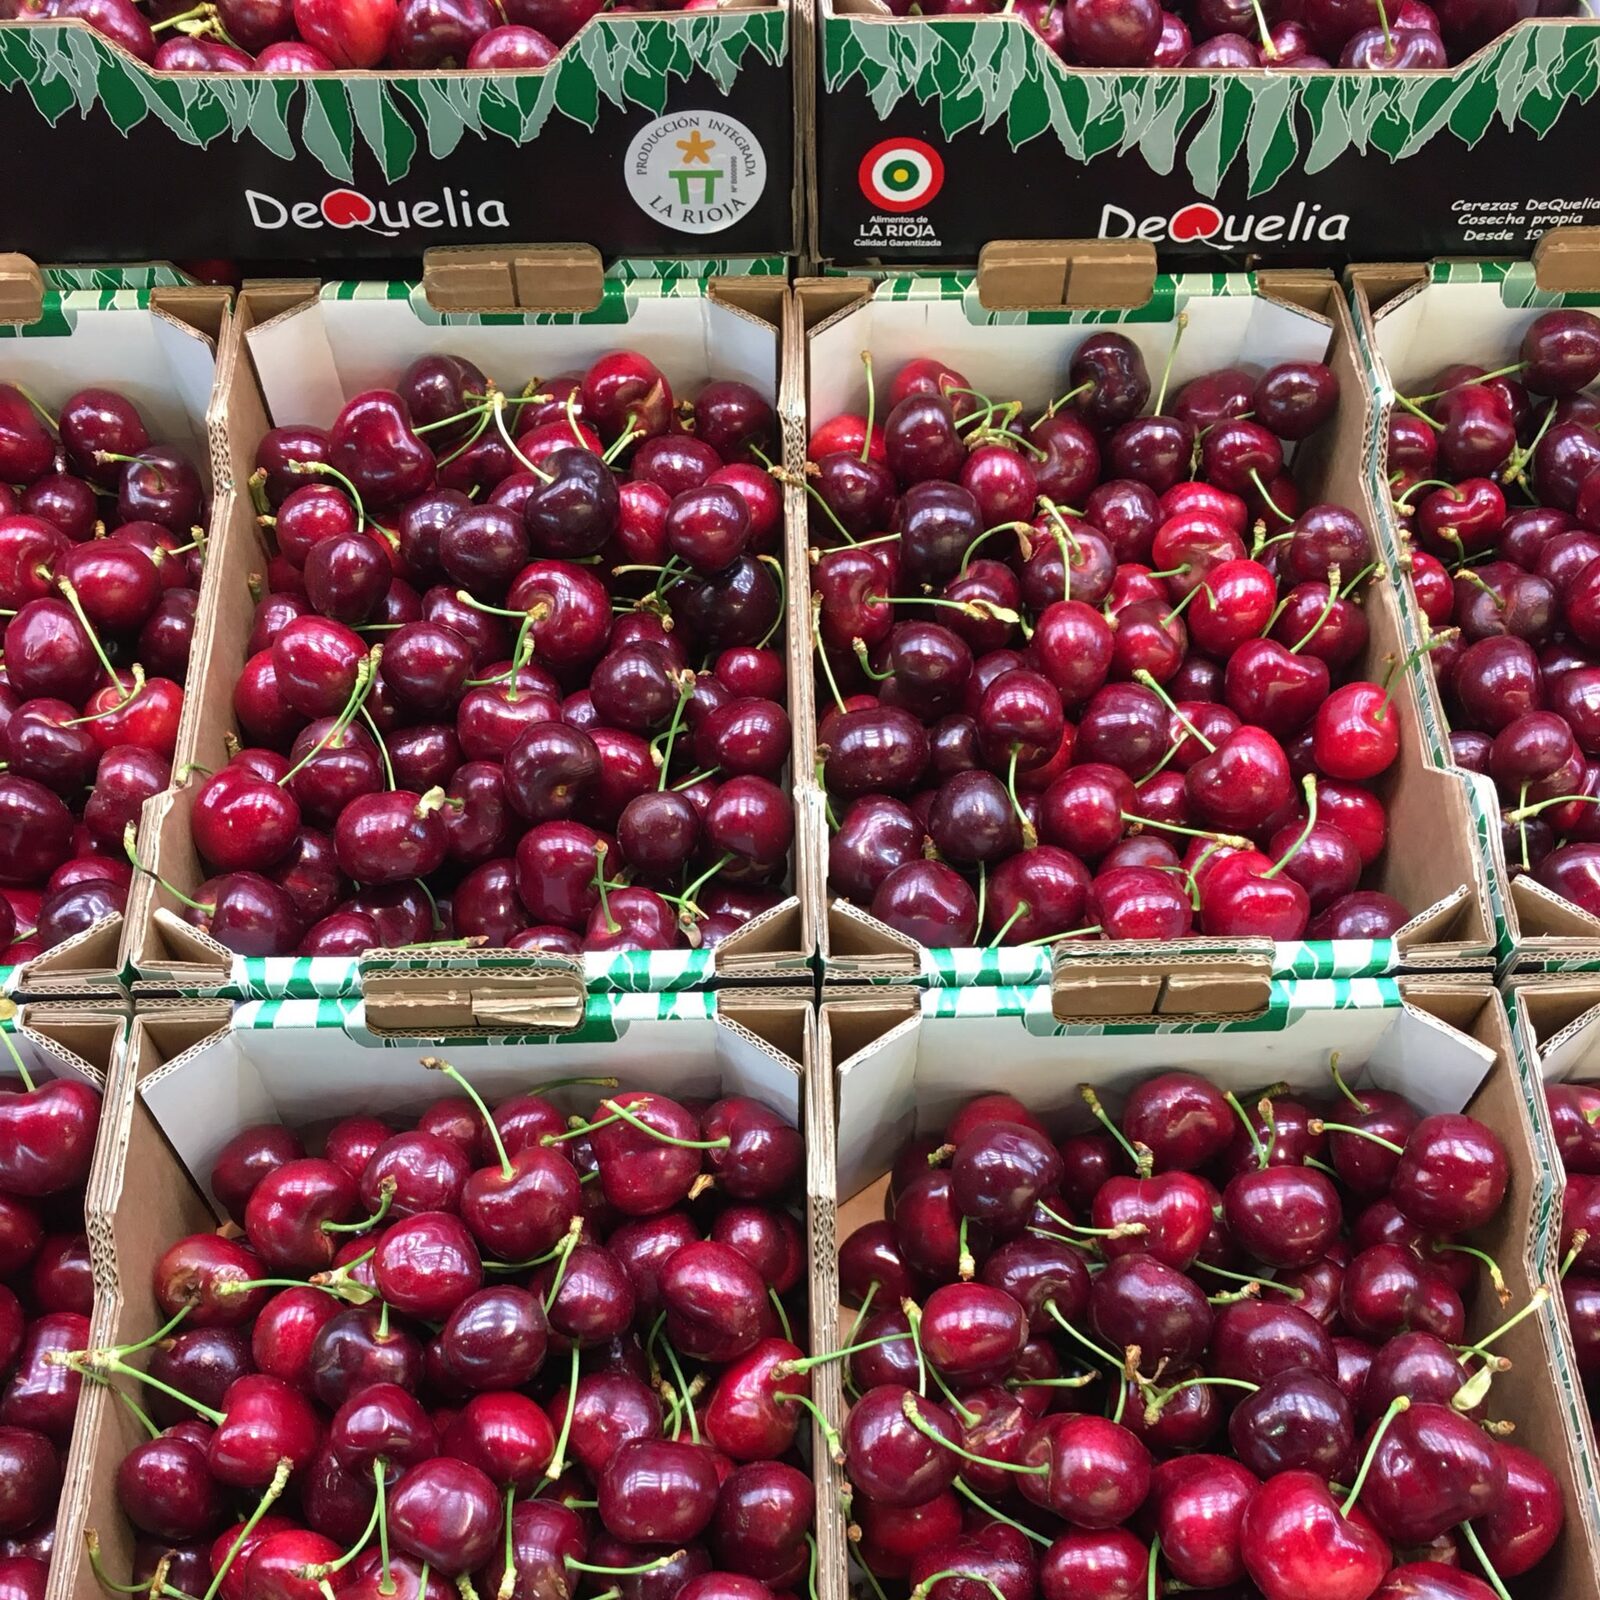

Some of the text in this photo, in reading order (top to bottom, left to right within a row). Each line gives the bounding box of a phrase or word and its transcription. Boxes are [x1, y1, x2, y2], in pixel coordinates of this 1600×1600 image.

[636, 117, 756, 177] PRODUCCIÓN INTEGRADA
[245, 187, 510, 237] DeQuelia
[649, 195, 747, 224] LA RIOJA
[1451, 197, 1600, 212] Cerezas DeQuelia
[1098, 201, 1350, 250] DeQuelia
[1457, 213, 1583, 227] Cosecha propia
[860, 224, 936, 238] LA RIOJA
[1463, 229, 1543, 241] Desde 19
[853, 239, 942, 247] Calidad Garantizada
